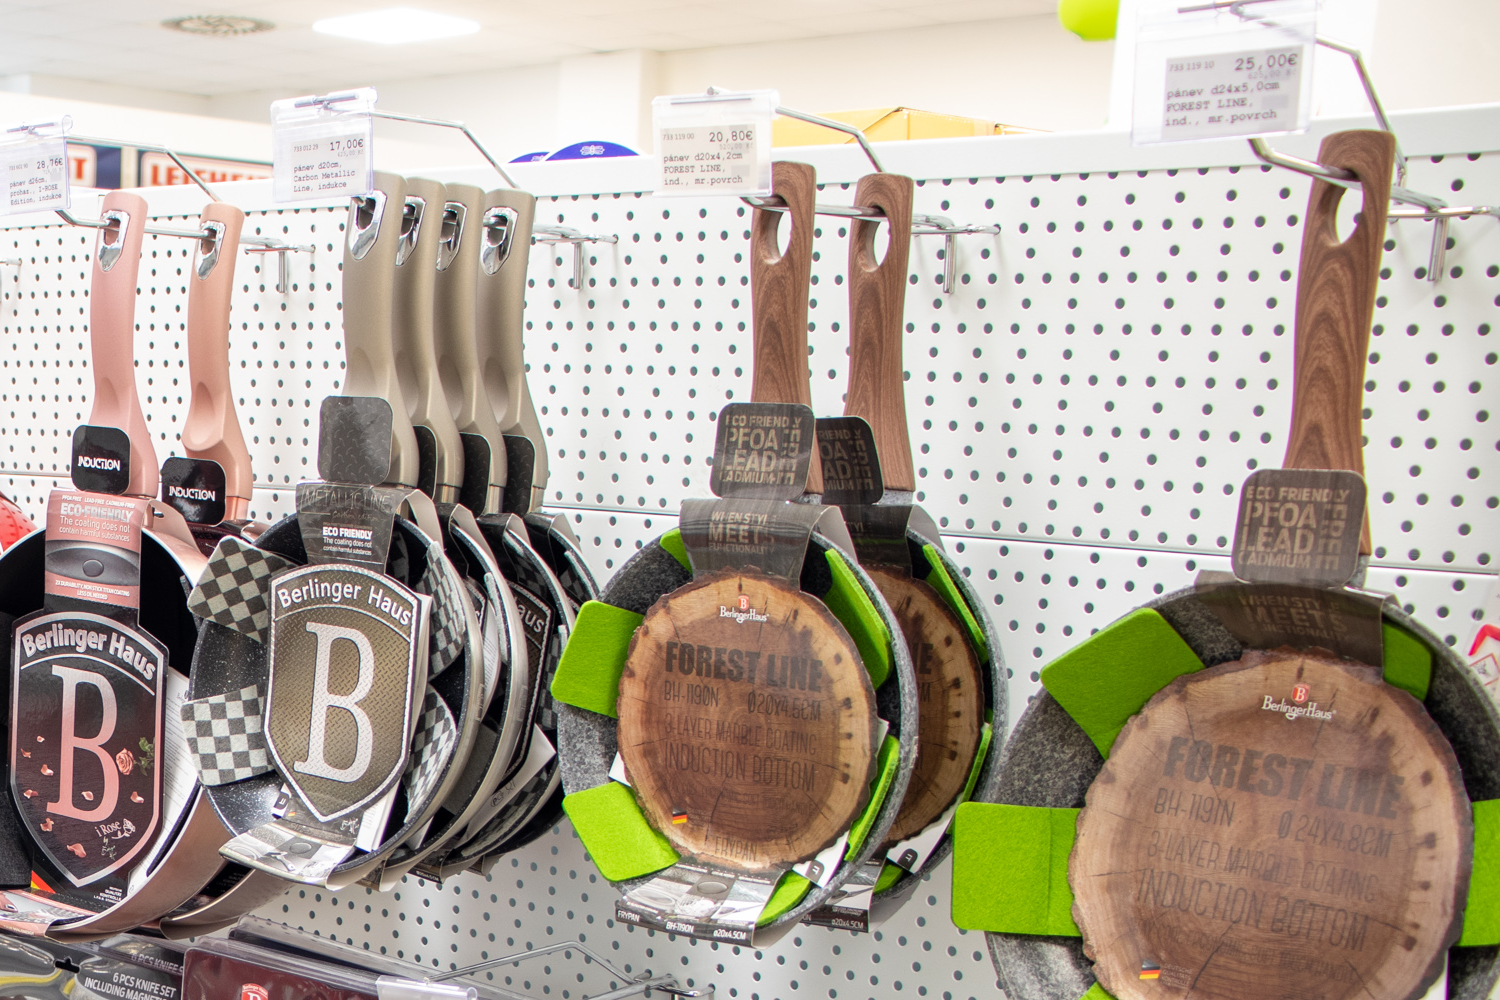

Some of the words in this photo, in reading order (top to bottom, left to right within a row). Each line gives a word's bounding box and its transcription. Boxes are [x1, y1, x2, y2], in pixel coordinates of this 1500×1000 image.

[1235, 53, 1298, 72] 25,00€
[1167, 88, 1204, 100] pánev
[1211, 80, 1280, 95] d24x5,0cm
[1166, 100, 1210, 112] FOREST
[1208, 109, 1277, 124] mr.povrch
[330, 139, 364, 151] 17,00€
[709, 131, 753, 143] 20,80€
[36, 158, 63, 170] 28,76€
[664, 155, 689, 164] pánev
[694, 152, 743, 161] d20x4,2cm
[293, 164, 314, 173] pánev
[293, 174, 318, 182] Carbon
[322, 170, 355, 180] Metallic
[664, 165, 695, 174] FOREST
[318, 181, 347, 190] indukce
[694, 175, 743, 186] mr.povrch
[78, 455, 121, 472] INDUCTION
[169, 485, 216, 502] INDUCTION
[1278, 486, 1350, 501] FRIENDLY
[60, 502, 133, 523] ECO-FRIENDLY
[1243, 500, 1317, 528] PFOA
[74, 518, 100, 530] coating
[322, 526, 339, 537] ECO
[339, 528, 373, 540] FRIENDLY
[101, 530, 130, 542] substances
[1240, 524, 1315, 555] LEAD
[1238, 552, 1311, 569] CADMIUM
[277, 578, 362, 609] Berlinger
[367, 584, 411, 626] Haus
[719, 604, 768, 624] BerlingerHaus
[21, 623, 107, 658] Berlinger
[108, 632, 156, 681] Haus
[664, 640, 763, 685] FOREST
[766, 653, 823, 694] LINE
[293, 621, 375, 783] B
[663, 680, 720, 708] BH-1190N
[1261, 694, 1333, 720] BerlingerHaus
[46, 664, 120, 823] B
[663, 711, 713, 741] 3-LAYER
[715, 718, 764, 746] MARBLE
[765, 727, 818, 757] COATING
[663, 742, 748, 781] INDUCTION
[752, 754, 816, 793] BOTTOM
[1162, 735, 1313, 801] FOREST
[1316, 762, 1405, 819] LINE
[714, 836, 759, 863] FRYPAN
[1148, 830, 1222, 873] 3-LAYER
[1223, 845, 1300, 887] MARBLE
[1299, 860, 1379, 903] COATING
[1136, 867, 1266, 930] INDUCTION
[1270, 897, 1369, 953] BOTTOM
[617, 910, 640, 923] FRYPAN
[665, 921, 695, 933] BH-1190N
[84, 976, 126, 1000] INCLUDING
[134, 976, 155, 994] KNIFE
[154, 984, 177, 999] SET
